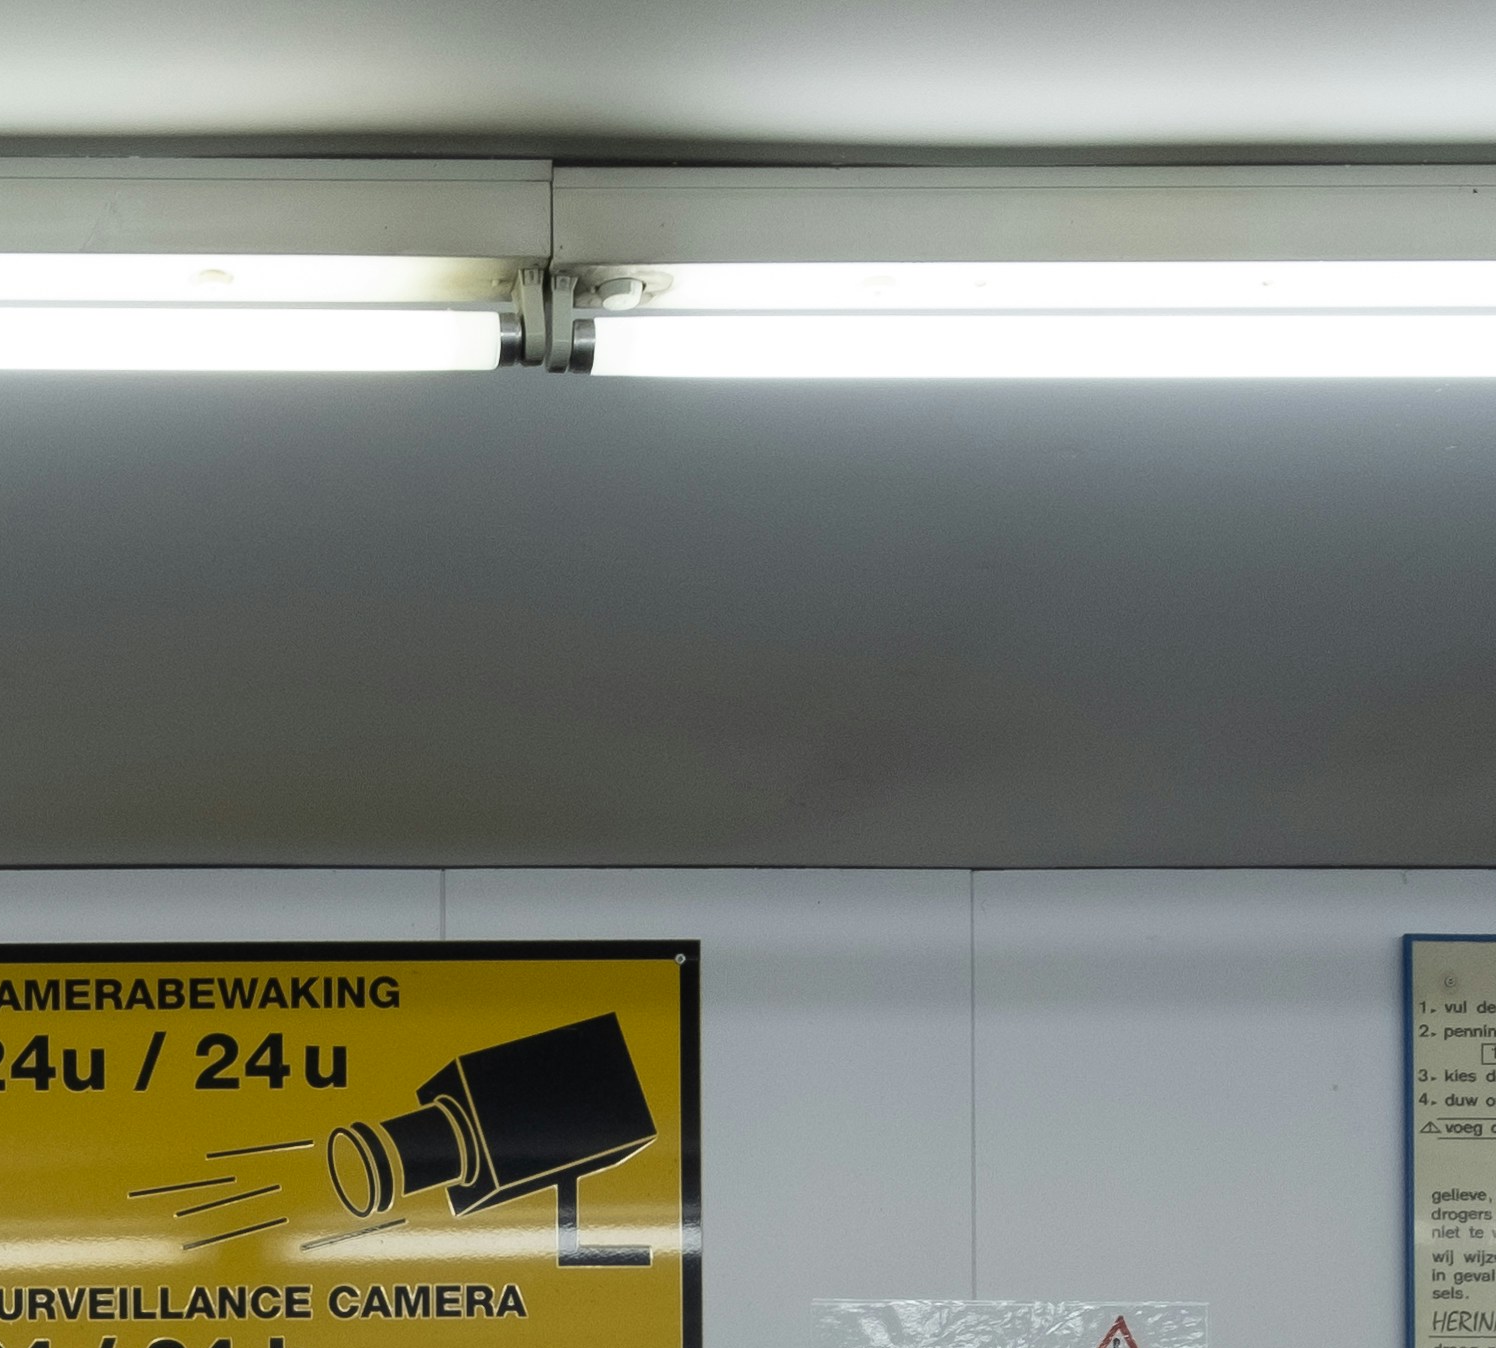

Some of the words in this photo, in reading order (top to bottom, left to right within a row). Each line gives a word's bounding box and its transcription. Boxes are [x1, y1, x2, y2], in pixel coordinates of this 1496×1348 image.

[1444, 1000, 1467, 1014] vul
[1477, 1000, 1496, 1014] de
[195, 1032, 349, 1091] 24u
[1444, 1069, 1476, 1083] kies
[1433, 1269, 1446, 1283] in
[1453, 1269, 1495, 1284] geval
[328, 1282, 527, 1319] CAMERA
